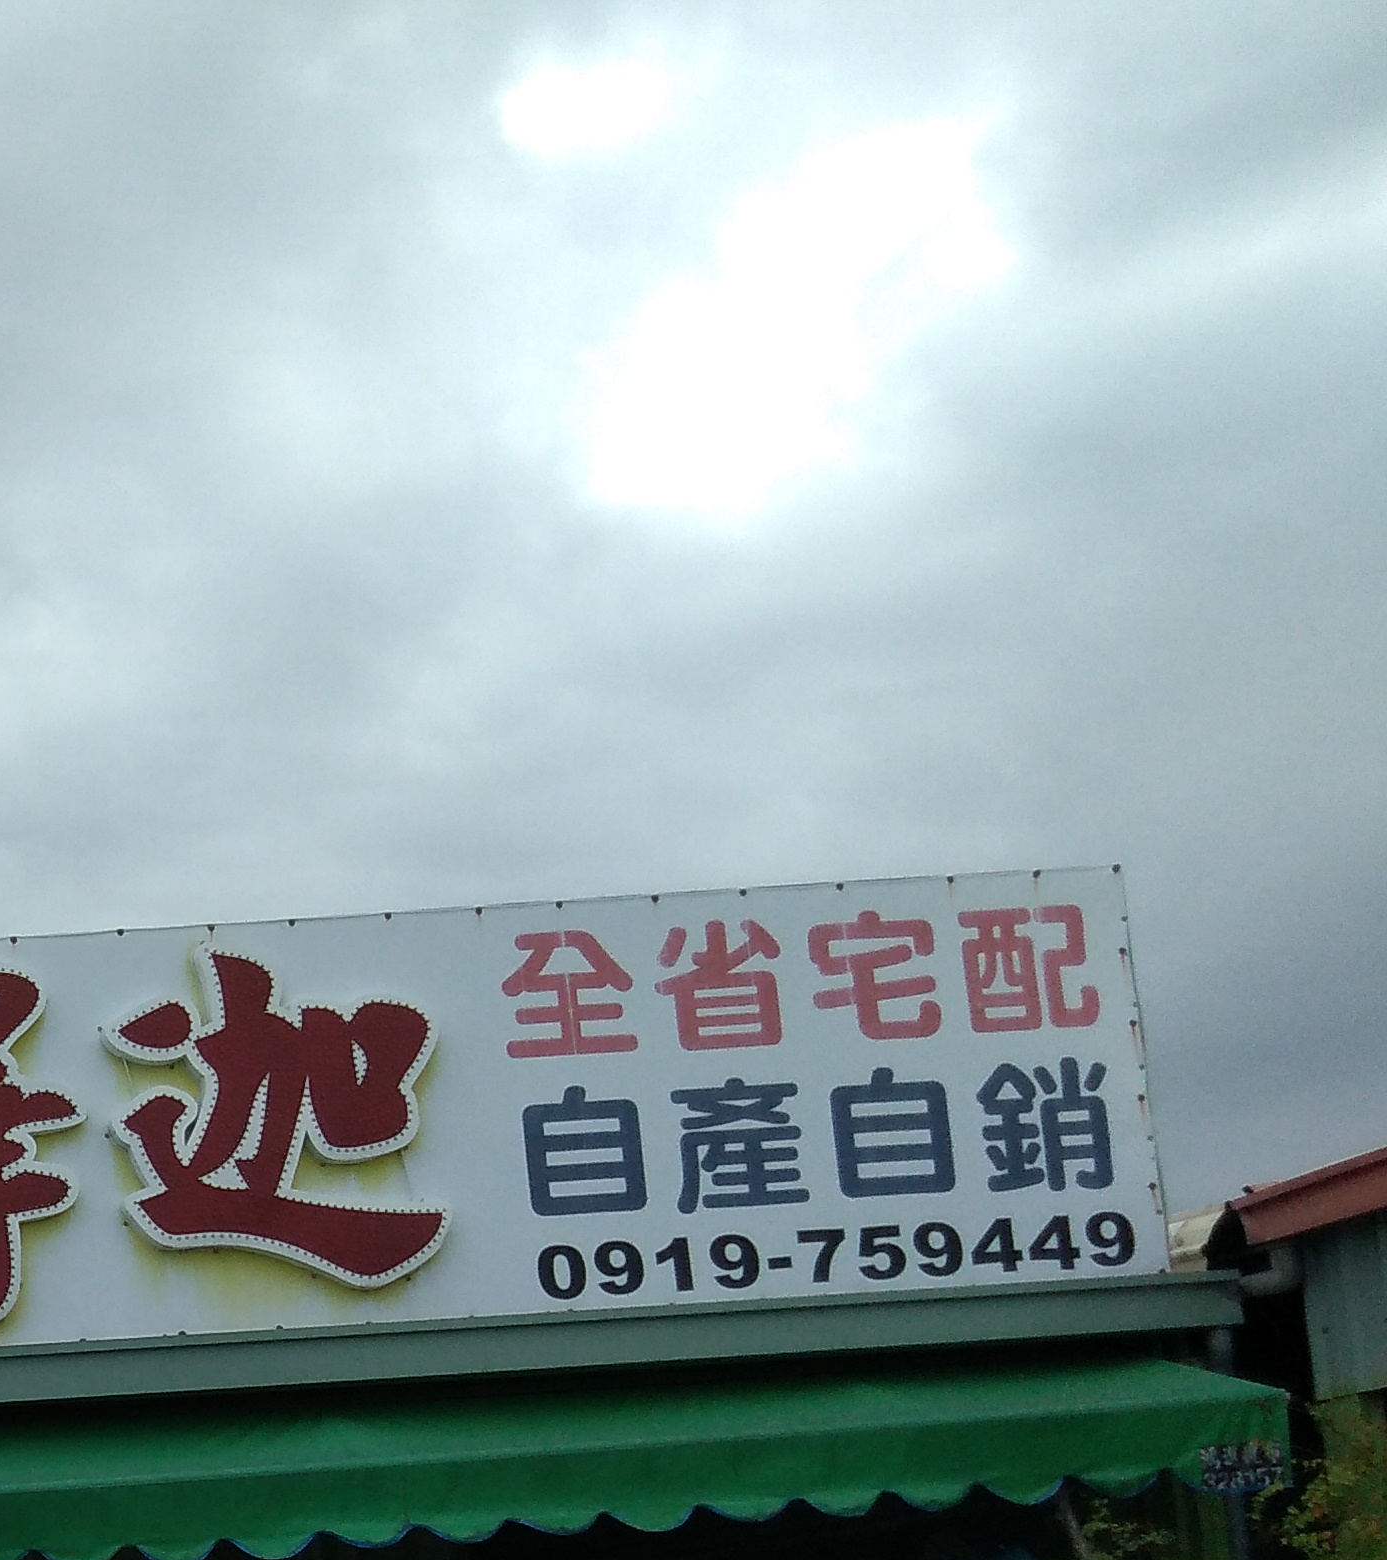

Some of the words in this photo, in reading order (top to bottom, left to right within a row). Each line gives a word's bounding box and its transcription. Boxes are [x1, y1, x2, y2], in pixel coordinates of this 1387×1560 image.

[501, 903, 1101, 1059] 全省宅配
[521, 1056, 1116, 1216] 自產自銷
[536, 1211, 1137, 1301] 0919-759449
